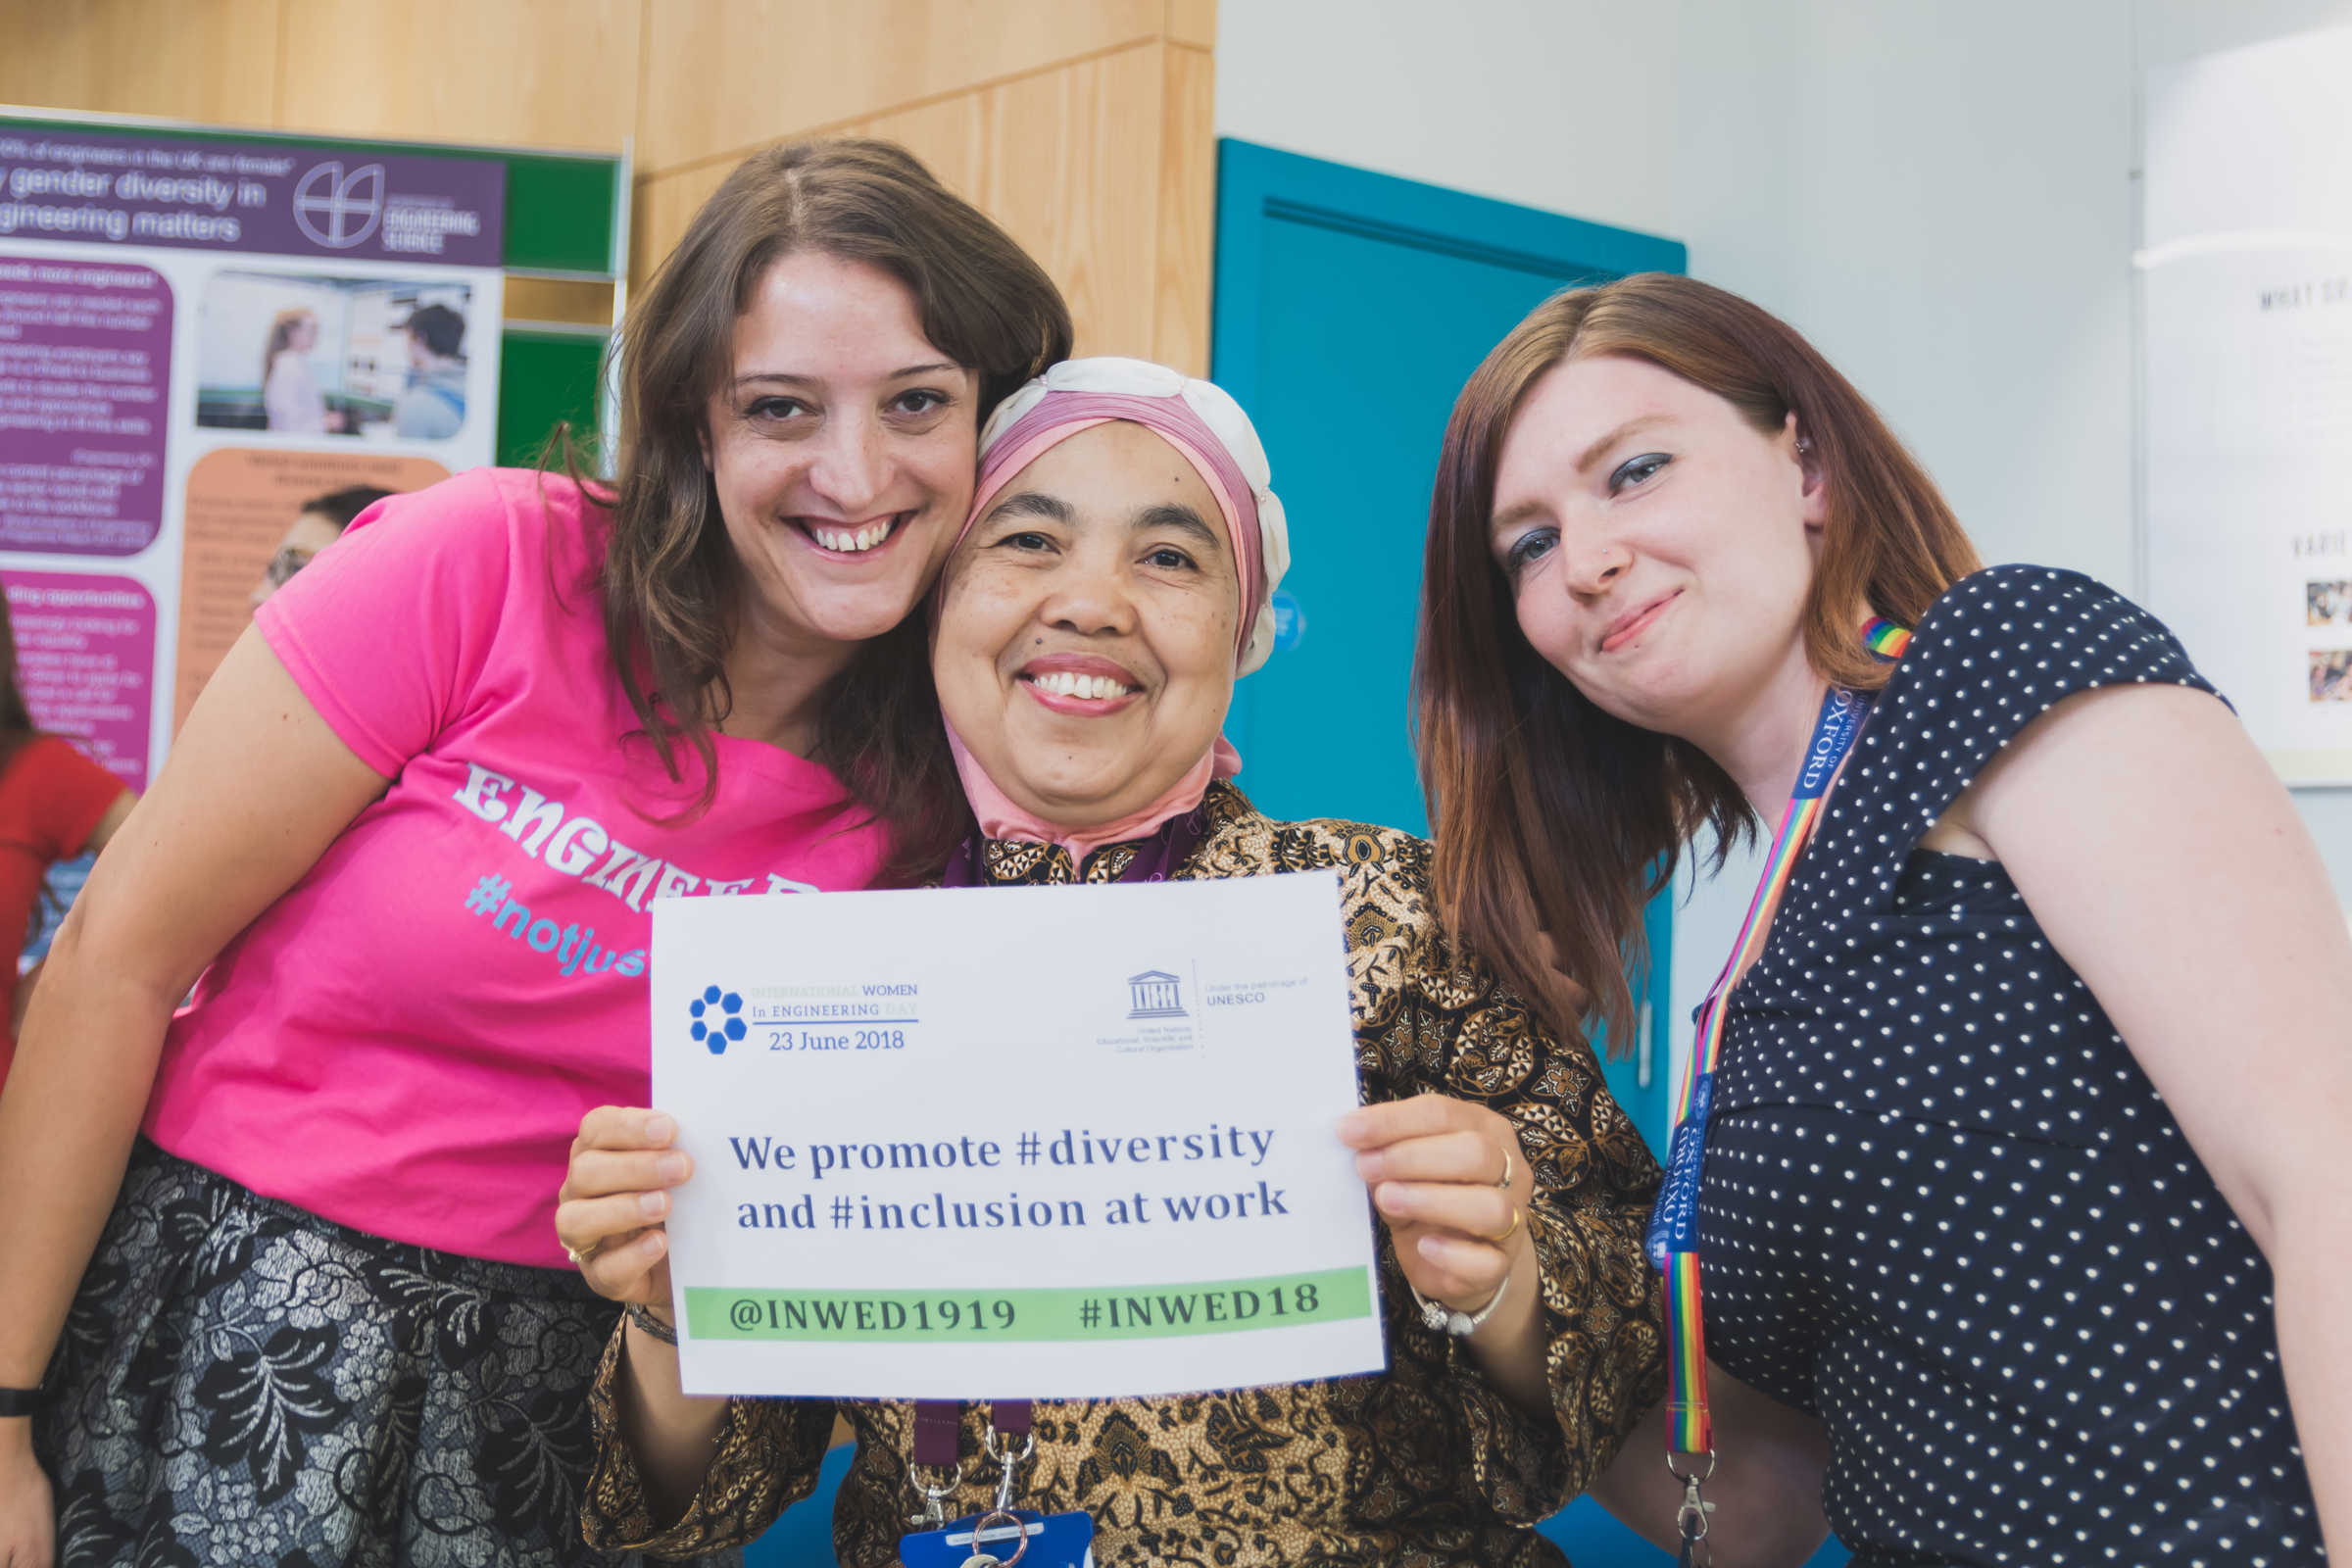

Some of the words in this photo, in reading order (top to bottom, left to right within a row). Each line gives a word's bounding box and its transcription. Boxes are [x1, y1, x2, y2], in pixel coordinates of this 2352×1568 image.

[10, 167, 114, 199] gender
[116, 170, 235, 212] diversity
[237, 177, 267, 208] in
[131, 210, 241, 242] matters
[1803, 689, 1853, 790] OXFORD
[465, 872, 652, 976] #notjus
[753, 1005, 765, 1018] In
[772, 1003, 880, 1017] ENGINEERING
[885, 1003, 918, 1014] DAY
[862, 984, 918, 997] WOMEN
[1206, 992, 1265, 1006] UNESCO
[769, 1032, 793, 1051] 23
[799, 1031, 850, 1051] June
[855, 1030, 905, 1050] 2018
[728, 1136, 796, 1170] We
[808, 1135, 1002, 1180] promote
[1016, 1123, 1275, 1166] #diversity
[737, 1194, 816, 1229] and
[830, 1192, 1087, 1229] #inclusion
[1105, 1193, 1152, 1225] at
[1161, 1181, 1290, 1223] work
[1675, 1128, 1697, 1240] OXFORD
[730, 1298, 1016, 1332] @INWED1919
[1079, 1283, 1320, 1329] #INWED18
